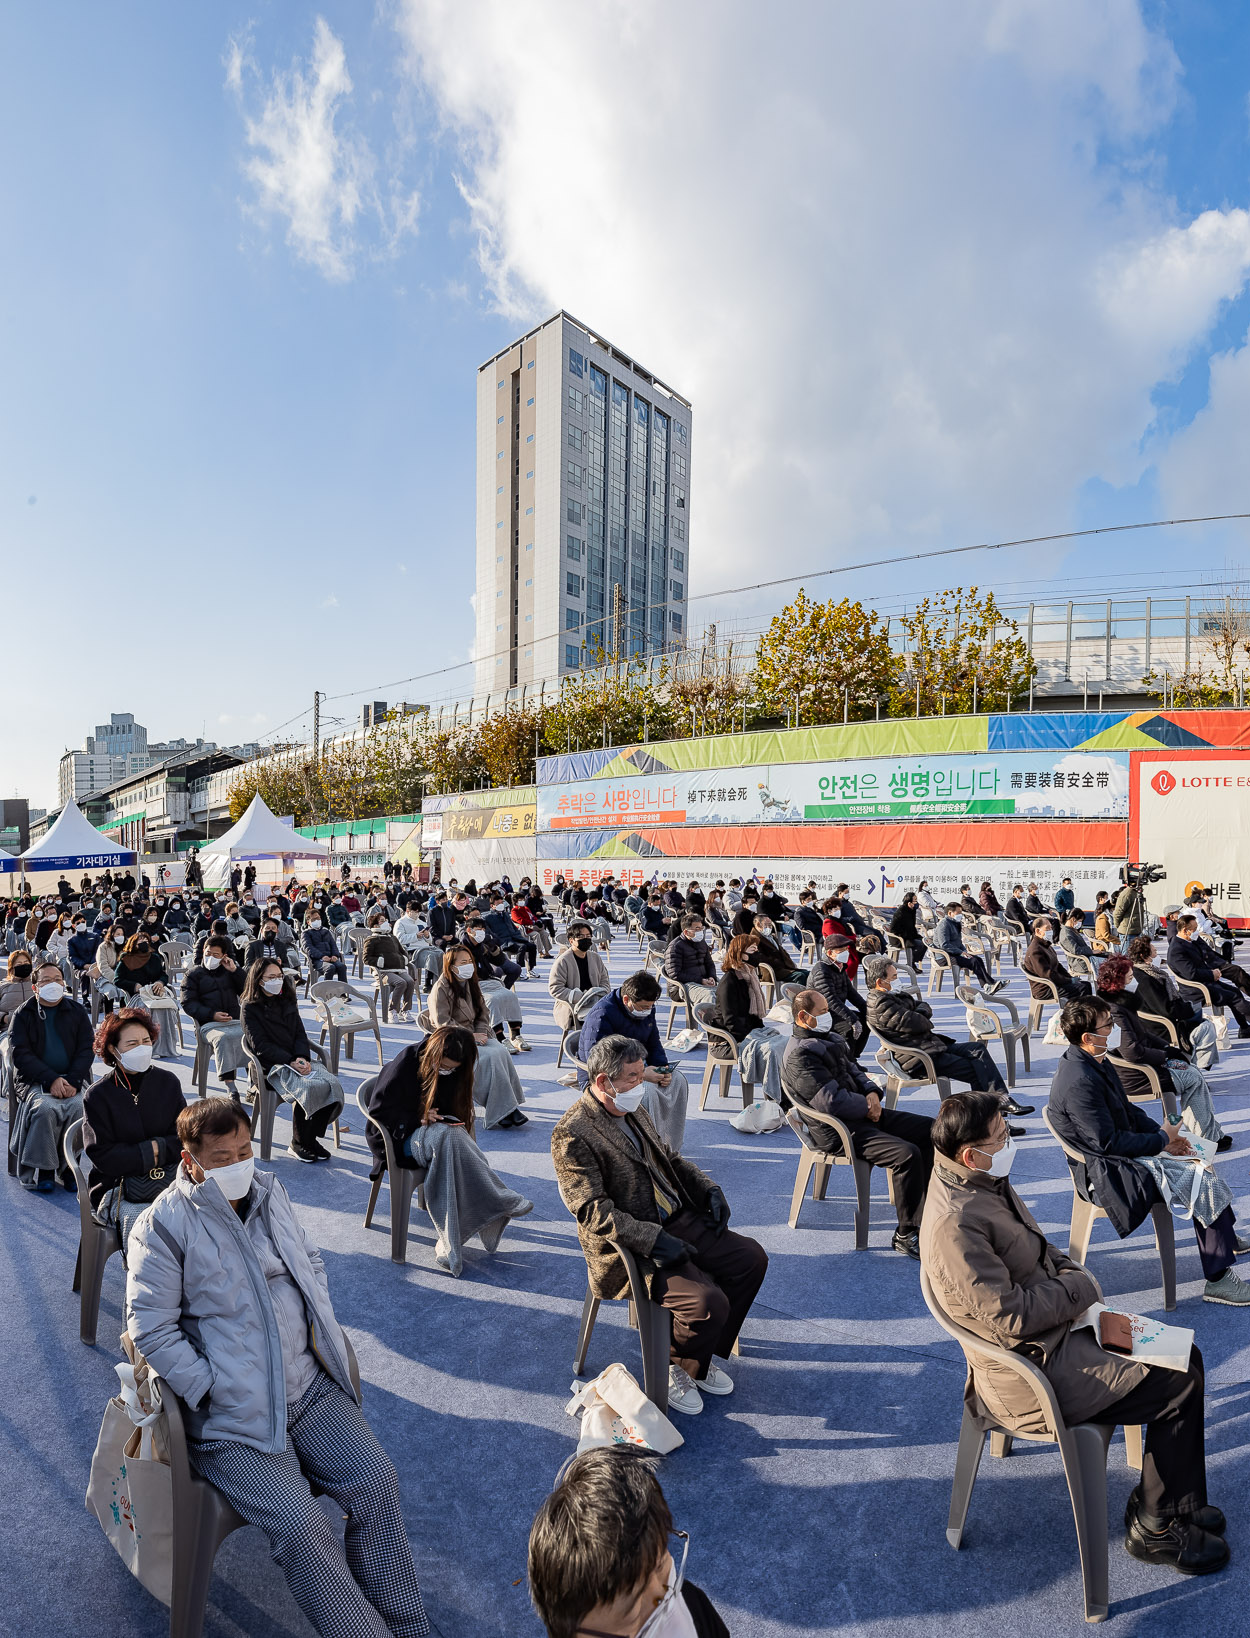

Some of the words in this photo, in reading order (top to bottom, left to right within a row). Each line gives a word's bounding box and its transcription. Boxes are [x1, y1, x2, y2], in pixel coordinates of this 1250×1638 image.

[818, 773, 880, 801] 안전은
[887, 764, 1001, 799] 생명입니다
[1010, 771, 1109, 789] 需要装备安全带
[1182, 777, 1232, 788] LOTTE
[557, 792, 598, 815] 추락은
[602, 784, 678, 812] 사망입니다
[687, 787, 748, 804] 掉下来就会死
[76, 855, 121, 867] 기자대기실
